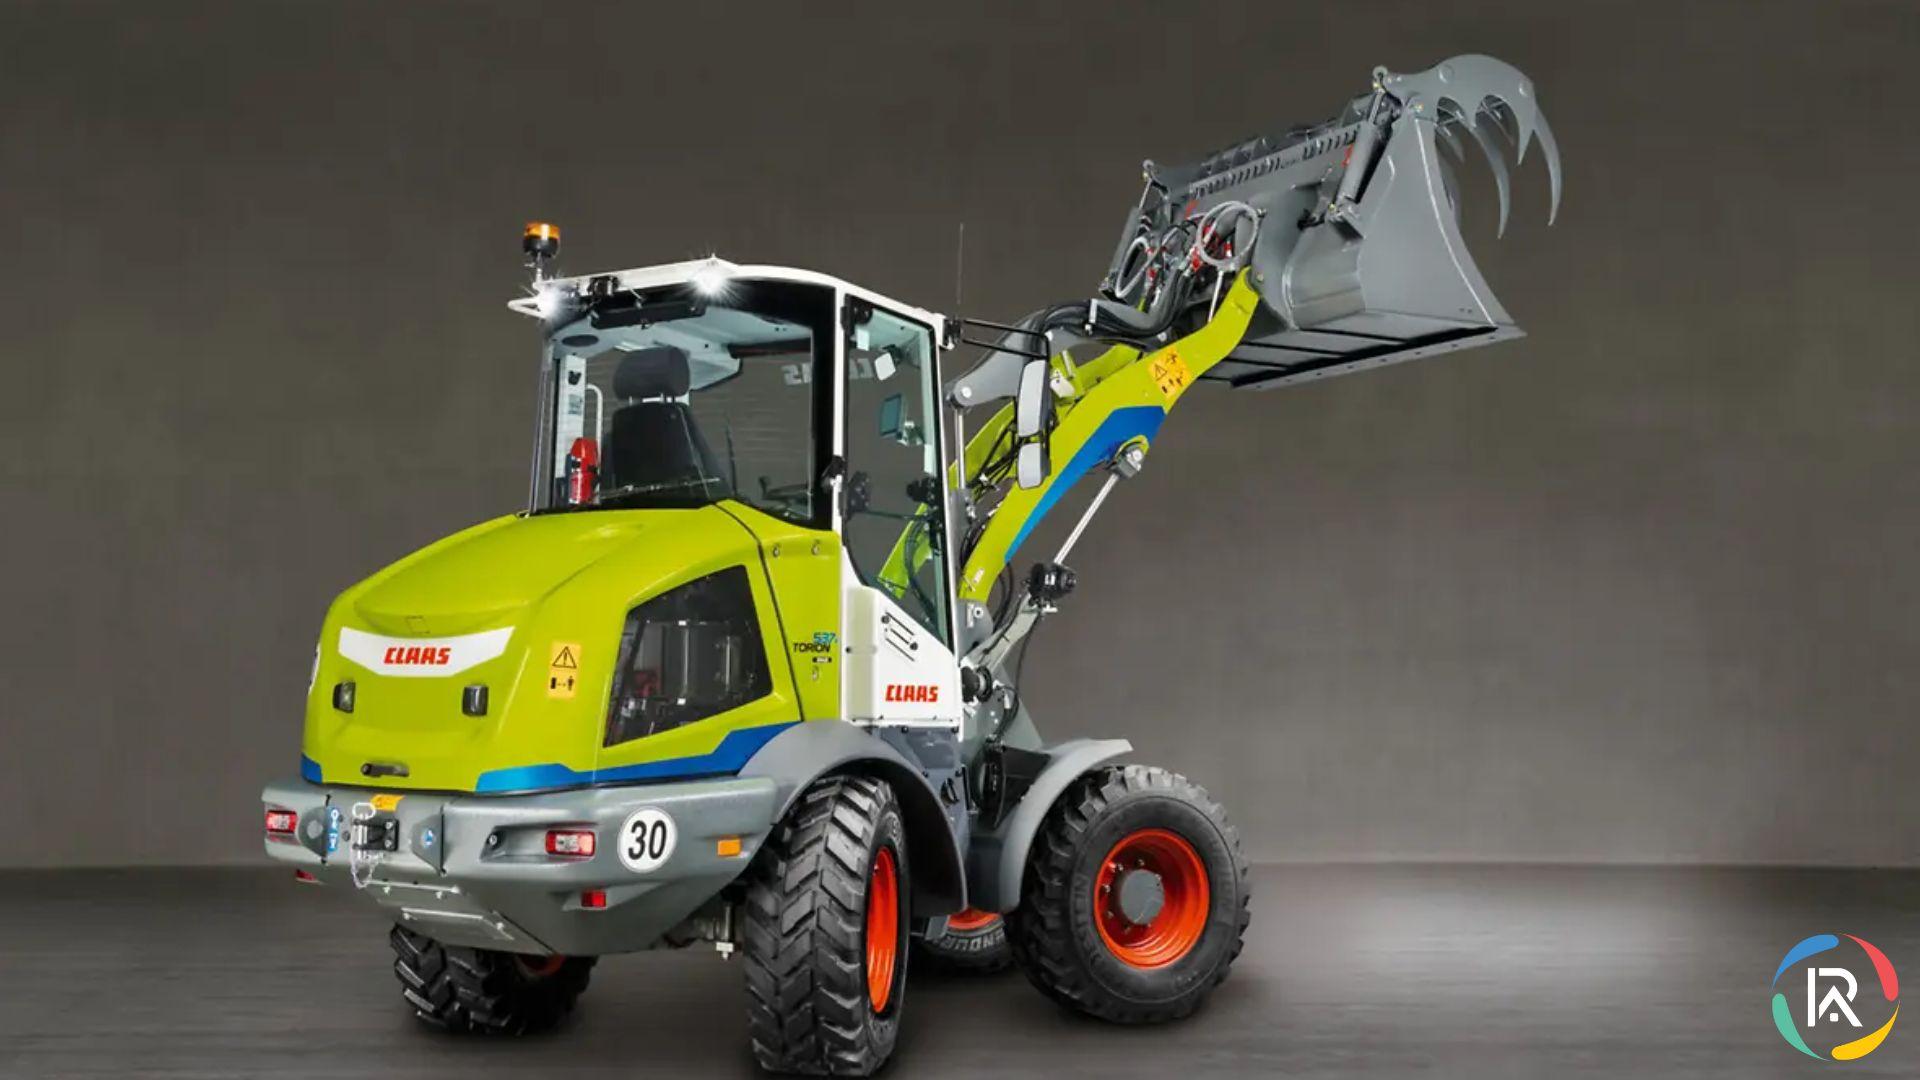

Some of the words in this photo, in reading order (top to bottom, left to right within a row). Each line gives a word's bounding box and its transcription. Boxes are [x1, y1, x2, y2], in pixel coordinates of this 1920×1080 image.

[384, 647, 452, 665] CLAAS
[793, 643, 831, 652] TORION
[886, 684, 939, 702] CLAAS
[628, 820, 667, 860] 30
